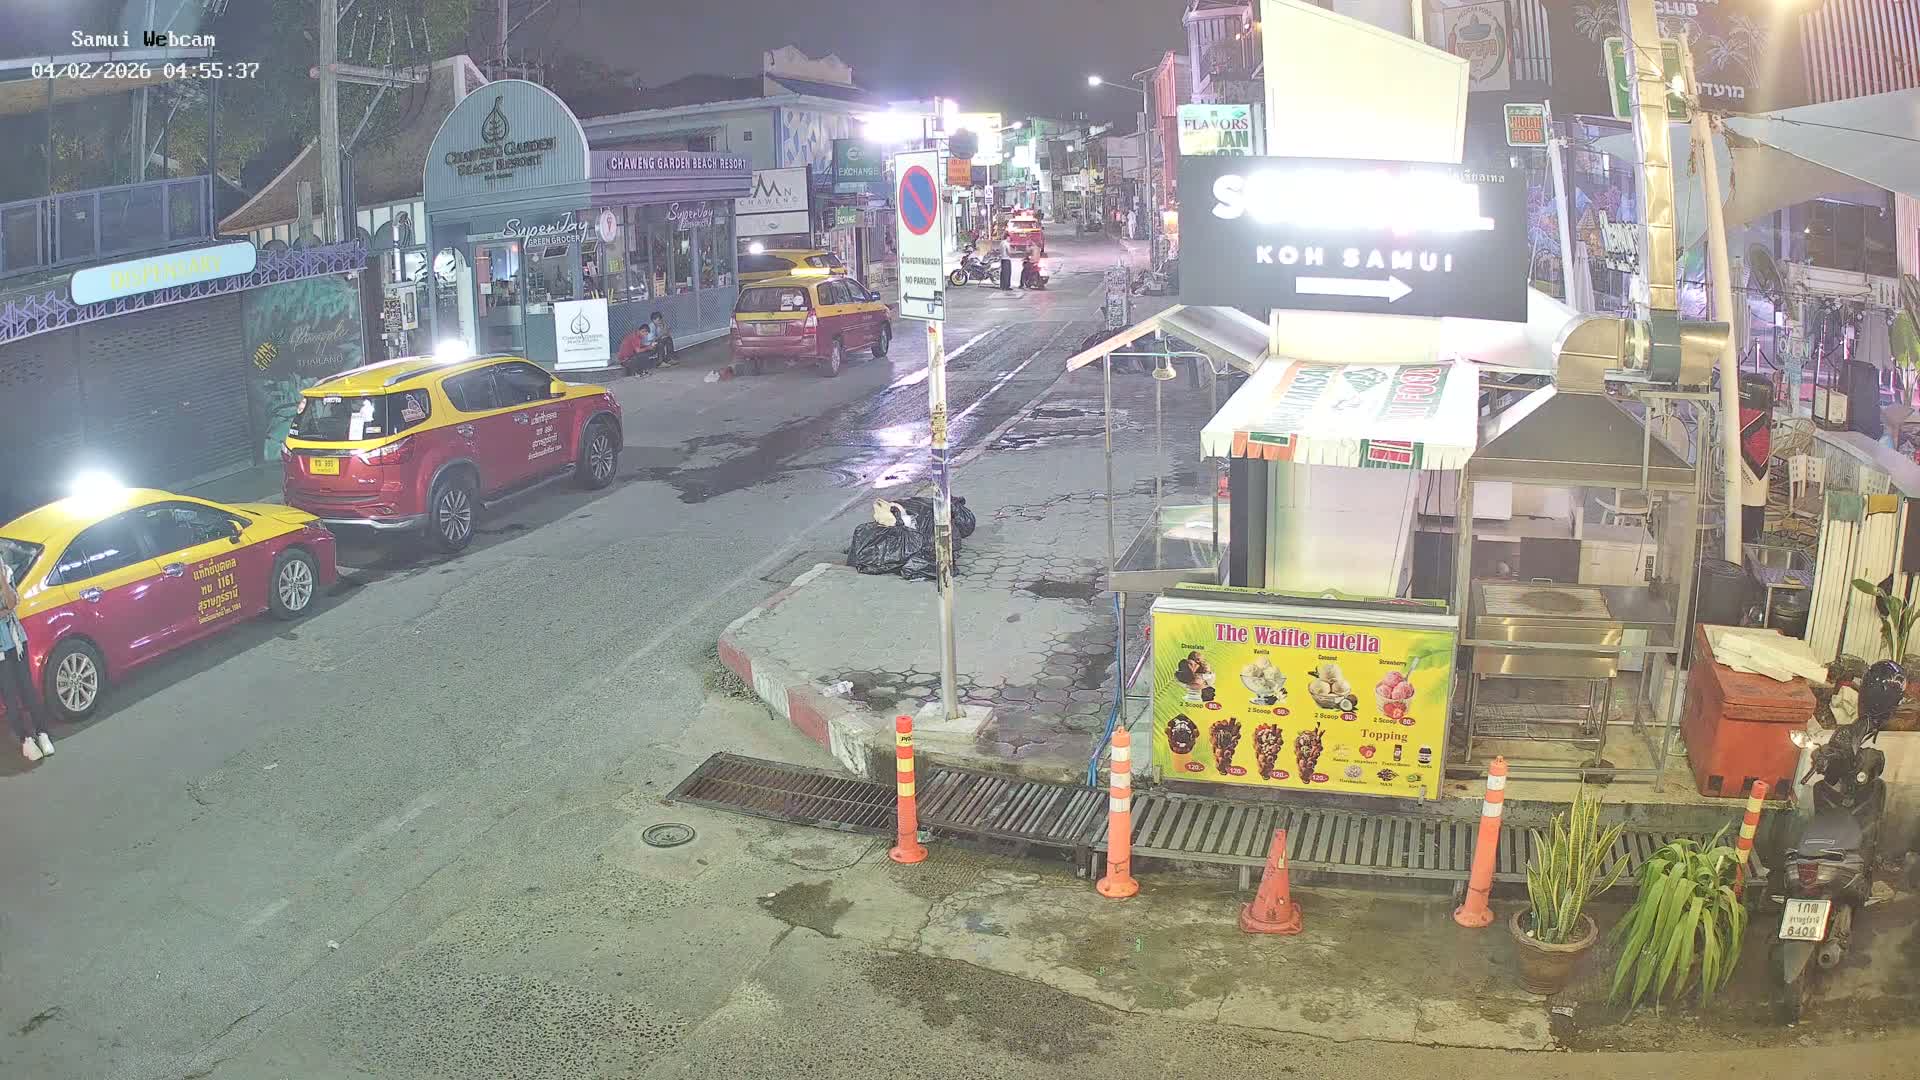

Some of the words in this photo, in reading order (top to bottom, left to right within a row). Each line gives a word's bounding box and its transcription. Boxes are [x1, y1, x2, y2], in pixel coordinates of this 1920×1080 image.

[1655, 1, 1698, 16] CLUB
[1183, 118, 1249, 130] FLAVORS
[611, 157, 654, 170] CHAWENG
[657, 157, 690, 170] GARDEN
[692, 158, 717, 169] BEACH
[719, 158, 746, 169] RESORT
[838, 167, 880, 177] EXCHANGE
[1256, 246, 1324, 266] KOH
[1342, 247, 1453, 272] SAMUI
[111, 255, 224, 292] DISPENSARY
[905, 275, 912, 285] NO
[913, 276, 937, 286] PARKING
[217, 573, 234, 589] 1161
[1215, 623, 1248, 643] The
[1254, 626, 1311, 648] Waffle
[1315, 632, 1380, 653] nutella
[1379, 659, 1407, 667] Strawberry
[1361, 729, 1408, 743] Topping
